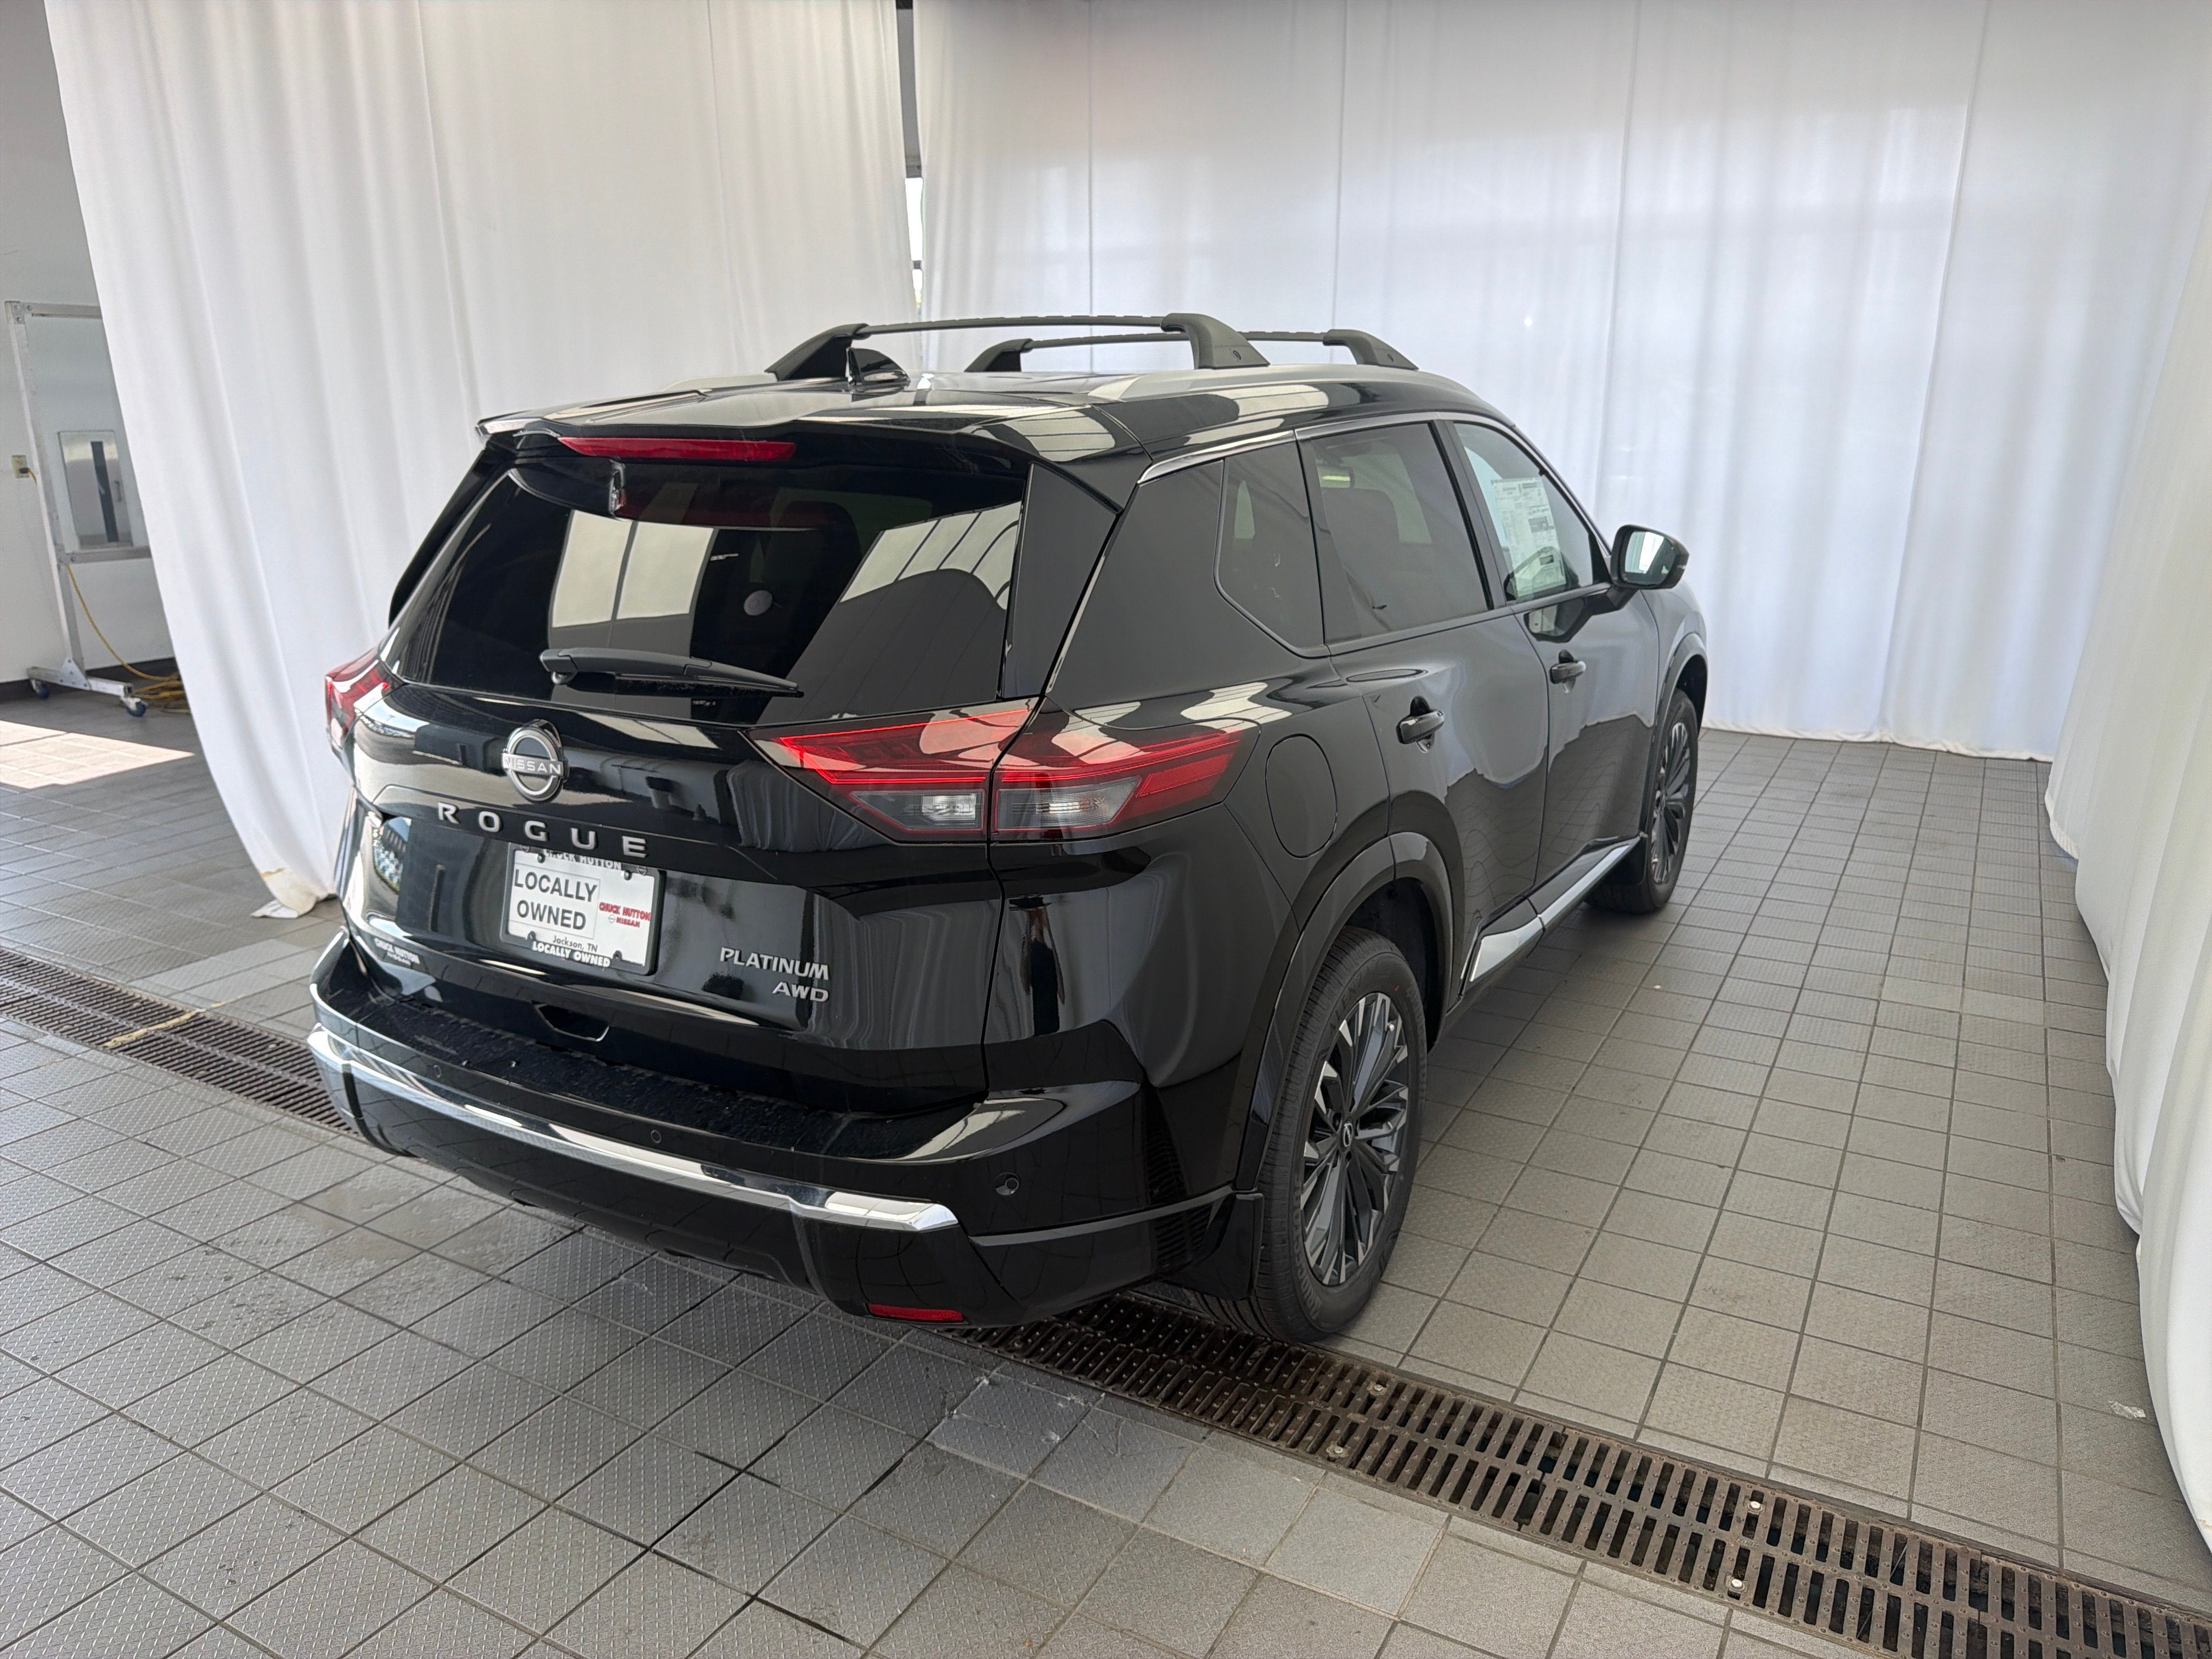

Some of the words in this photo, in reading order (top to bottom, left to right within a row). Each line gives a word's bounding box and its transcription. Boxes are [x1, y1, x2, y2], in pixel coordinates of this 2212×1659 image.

[504, 756, 561, 775] NISSAN
[438, 802, 648, 857] ROGUE
[579, 855, 622, 870] HUTTON
[514, 868, 597, 902] LOCALLY
[517, 899, 586, 930] OWNED
[532, 941, 572, 958] LOCALLY
[573, 951, 611, 968] OWNED
[552, 935, 585, 951] Jackson,
[587, 943, 598, 953] TN
[720, 946, 830, 980] PLATINUM
[772, 981, 829, 1002] AWD
